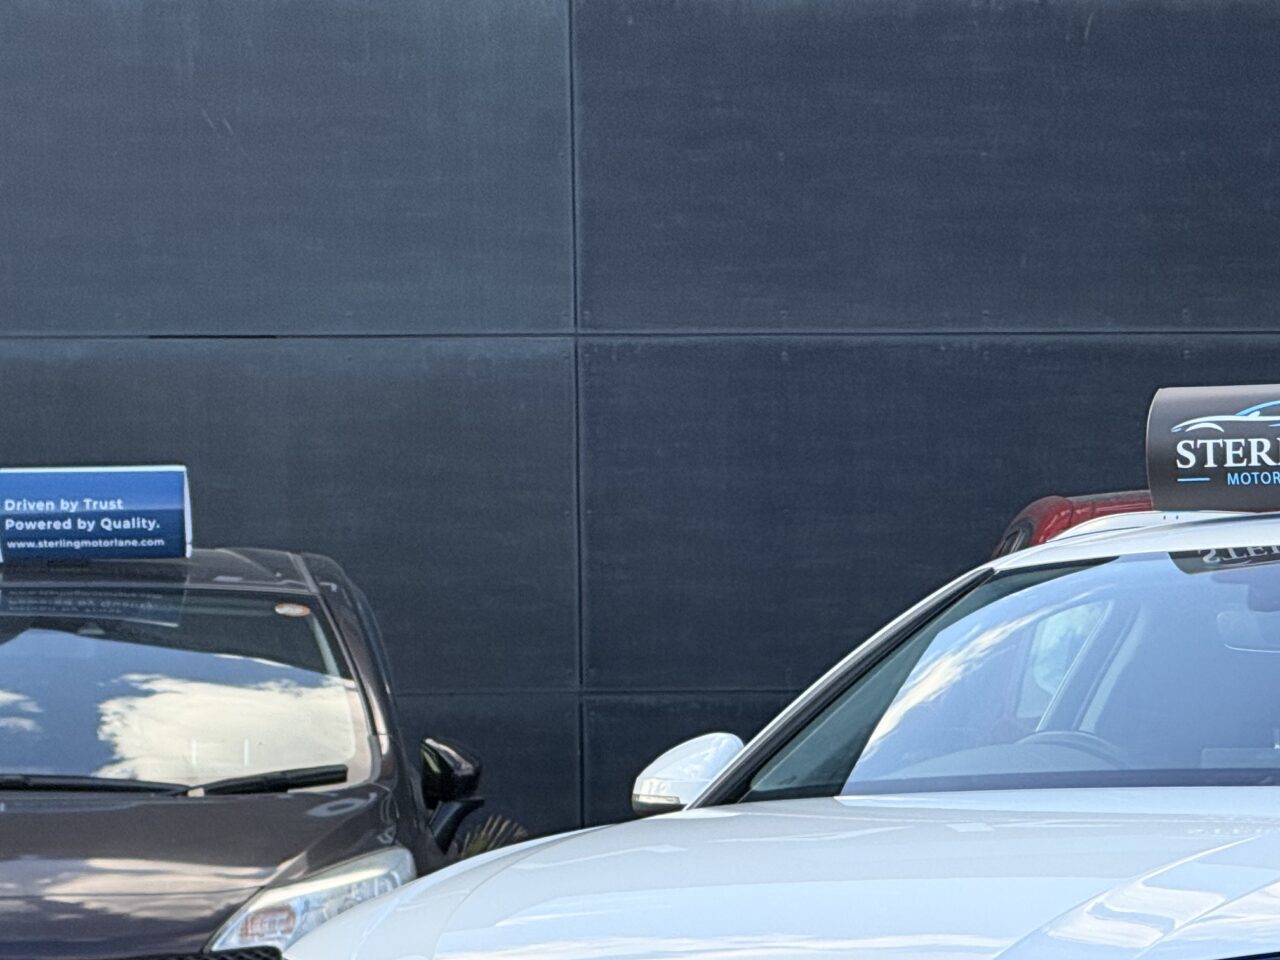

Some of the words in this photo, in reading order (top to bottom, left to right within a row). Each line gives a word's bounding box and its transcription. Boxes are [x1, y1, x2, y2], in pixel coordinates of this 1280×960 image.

[1227, 472, 1280, 486] MOTOR
[4, 499, 55, 511] Driven
[60, 498, 78, 512] by
[5, 518, 72, 530] Powered
[77, 518, 95, 532] by
[100, 517, 160, 531] Quality.
[7, 538, 165, 549] www.sterlingmotorlane.com
